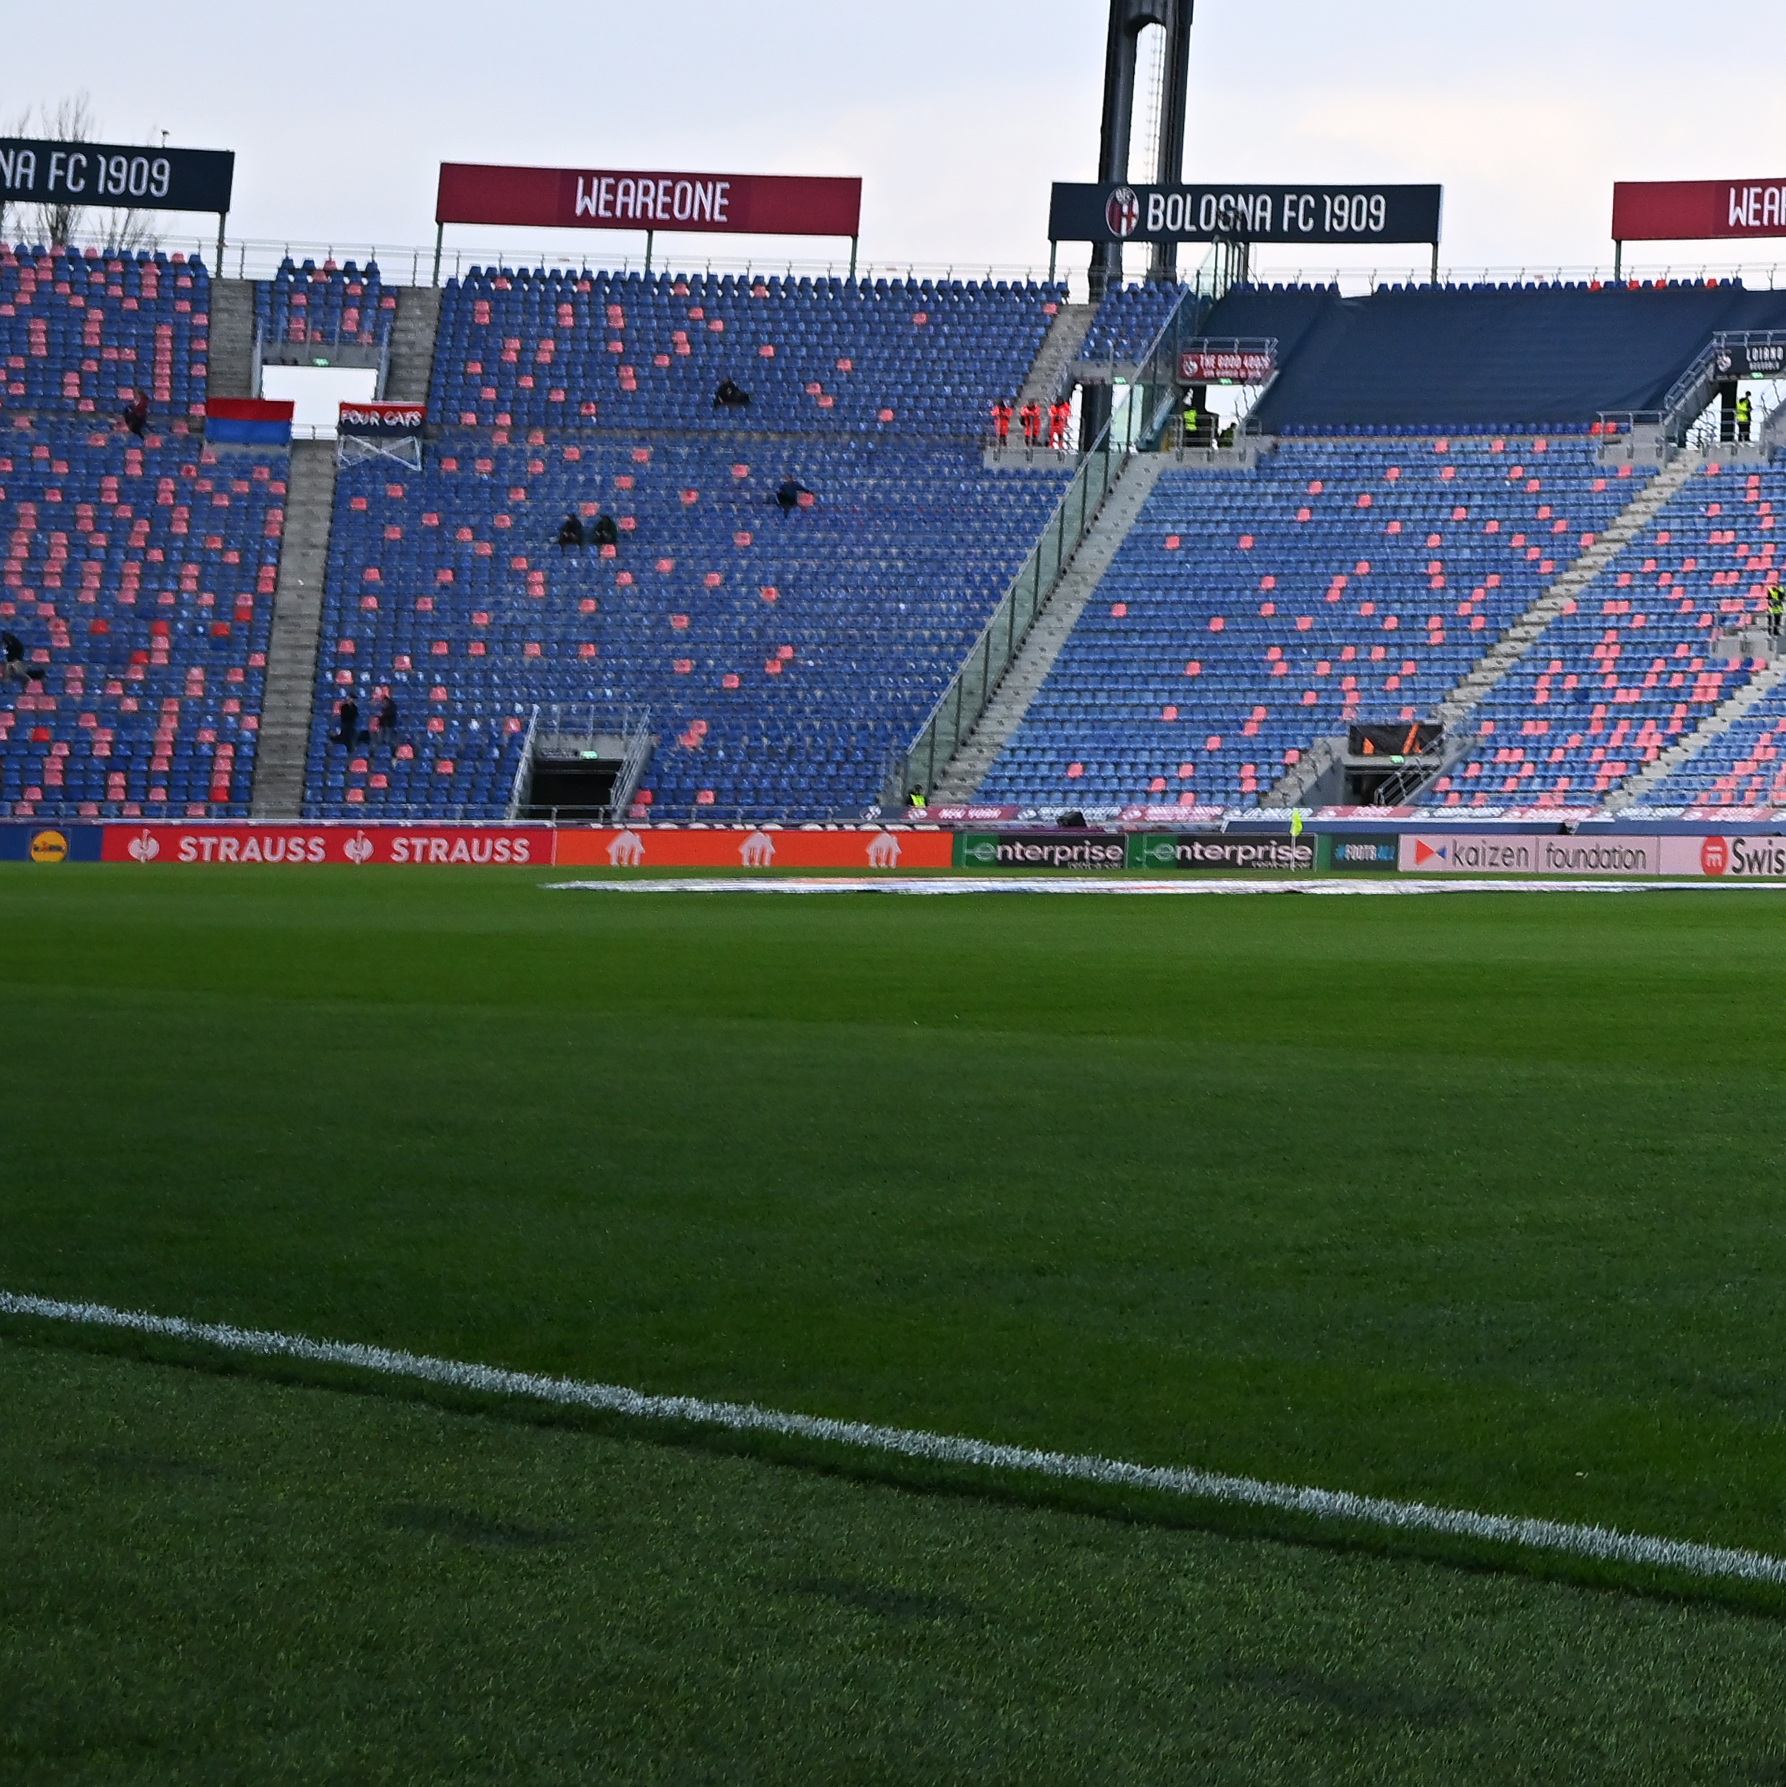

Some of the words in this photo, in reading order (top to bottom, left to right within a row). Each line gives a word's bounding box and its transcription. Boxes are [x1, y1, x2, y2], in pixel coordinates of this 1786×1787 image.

[48, 151, 87, 192] FC
[97, 154, 171, 198] 1909
[575, 175, 730, 224] WEAREONE
[1147, 193, 1272, 232] BOLOGNA
[1282, 194, 1315, 232] FC
[1322, 194, 1386, 232] 1909
[341, 409, 380, 427] FOUR
[178, 835, 326, 863] STRAUSS
[391, 836, 530, 863] STRAUSS
[973, 840, 1124, 866] enterprise
[1154, 840, 1311, 867] enterprise
[1452, 838, 1530, 868] kaizen
[1545, 840, 1648, 871] foundation
